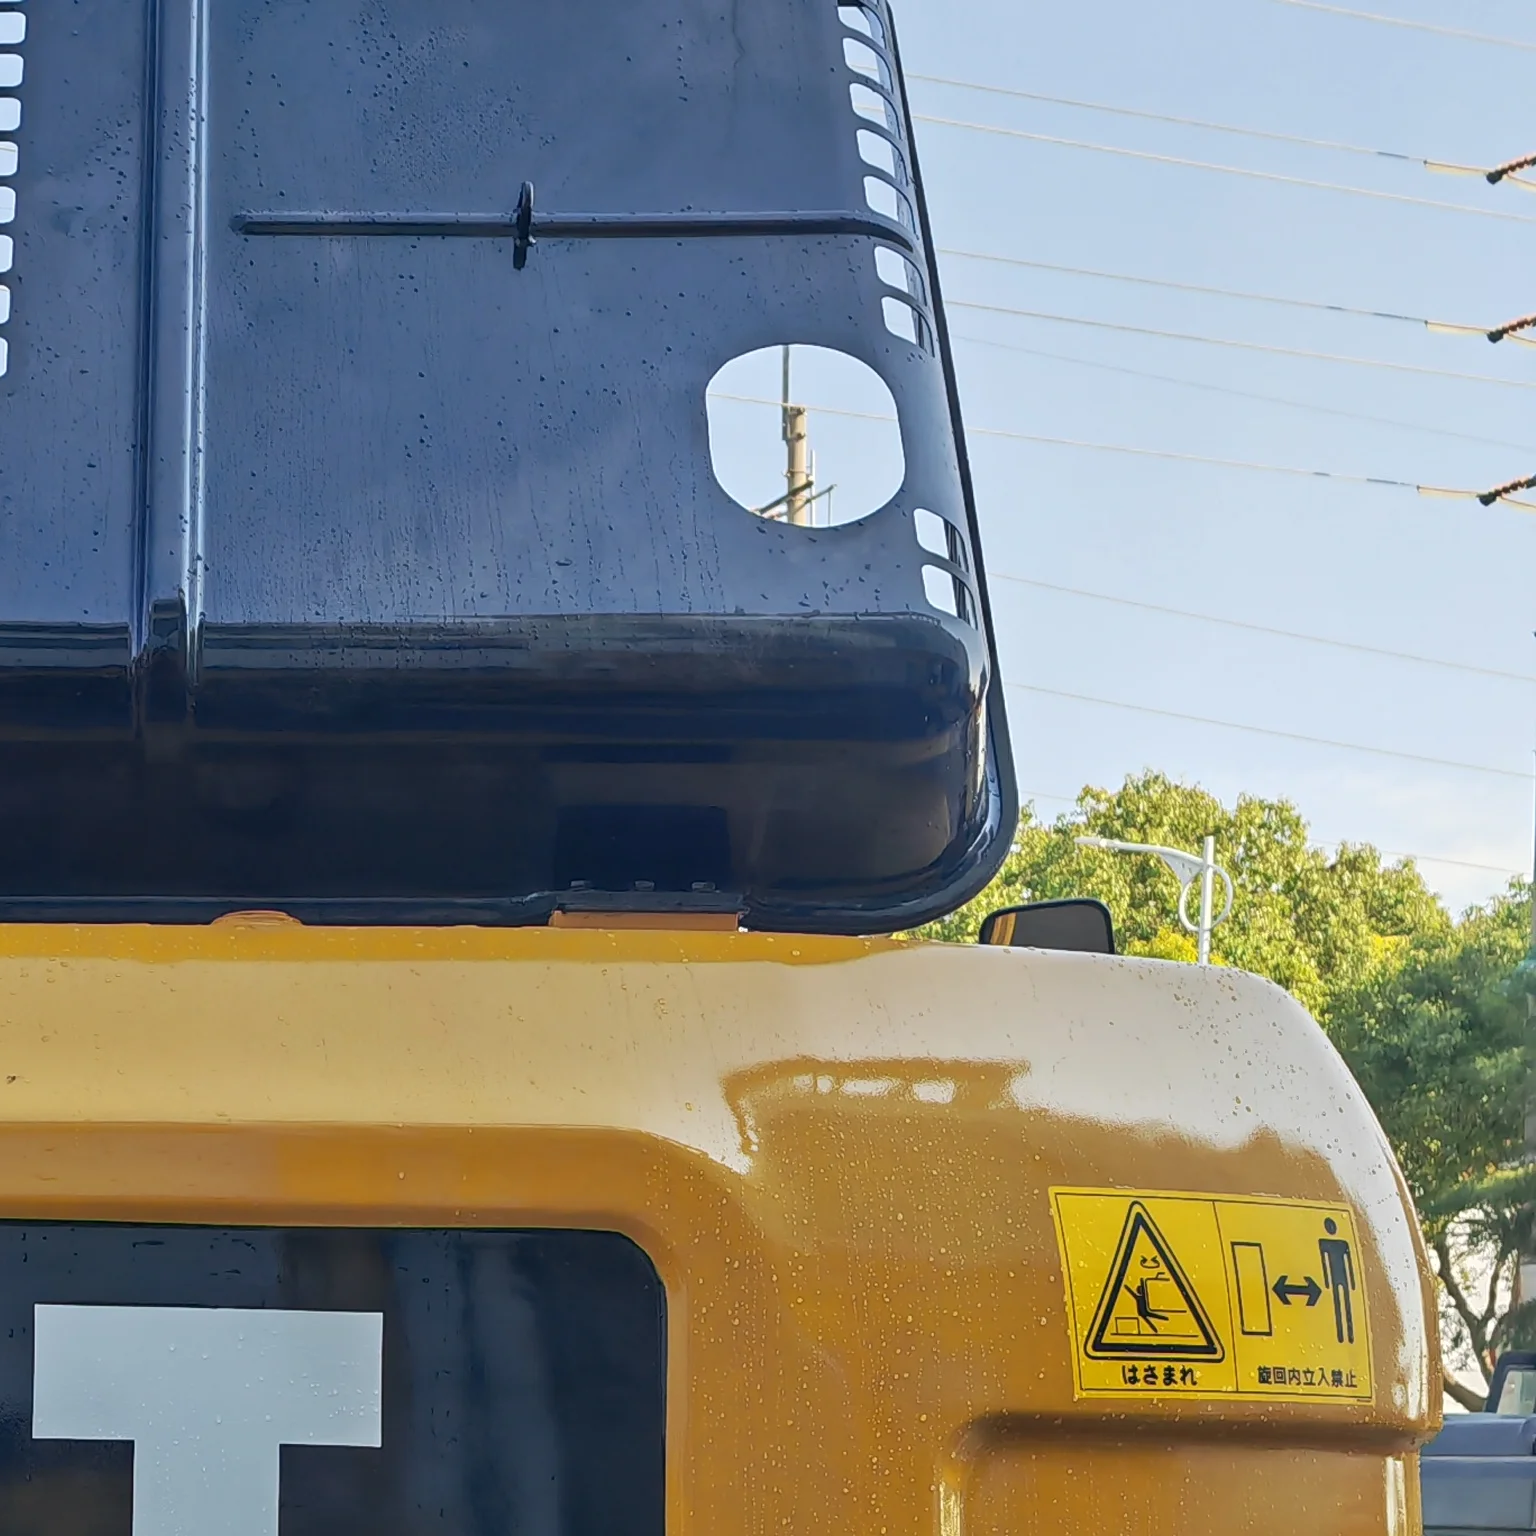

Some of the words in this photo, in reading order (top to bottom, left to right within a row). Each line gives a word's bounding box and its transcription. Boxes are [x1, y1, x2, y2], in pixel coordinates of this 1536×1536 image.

[1122, 1365, 1197, 1385] はさまれ
[1258, 1366, 1357, 1388] 旋回内立入禁止
